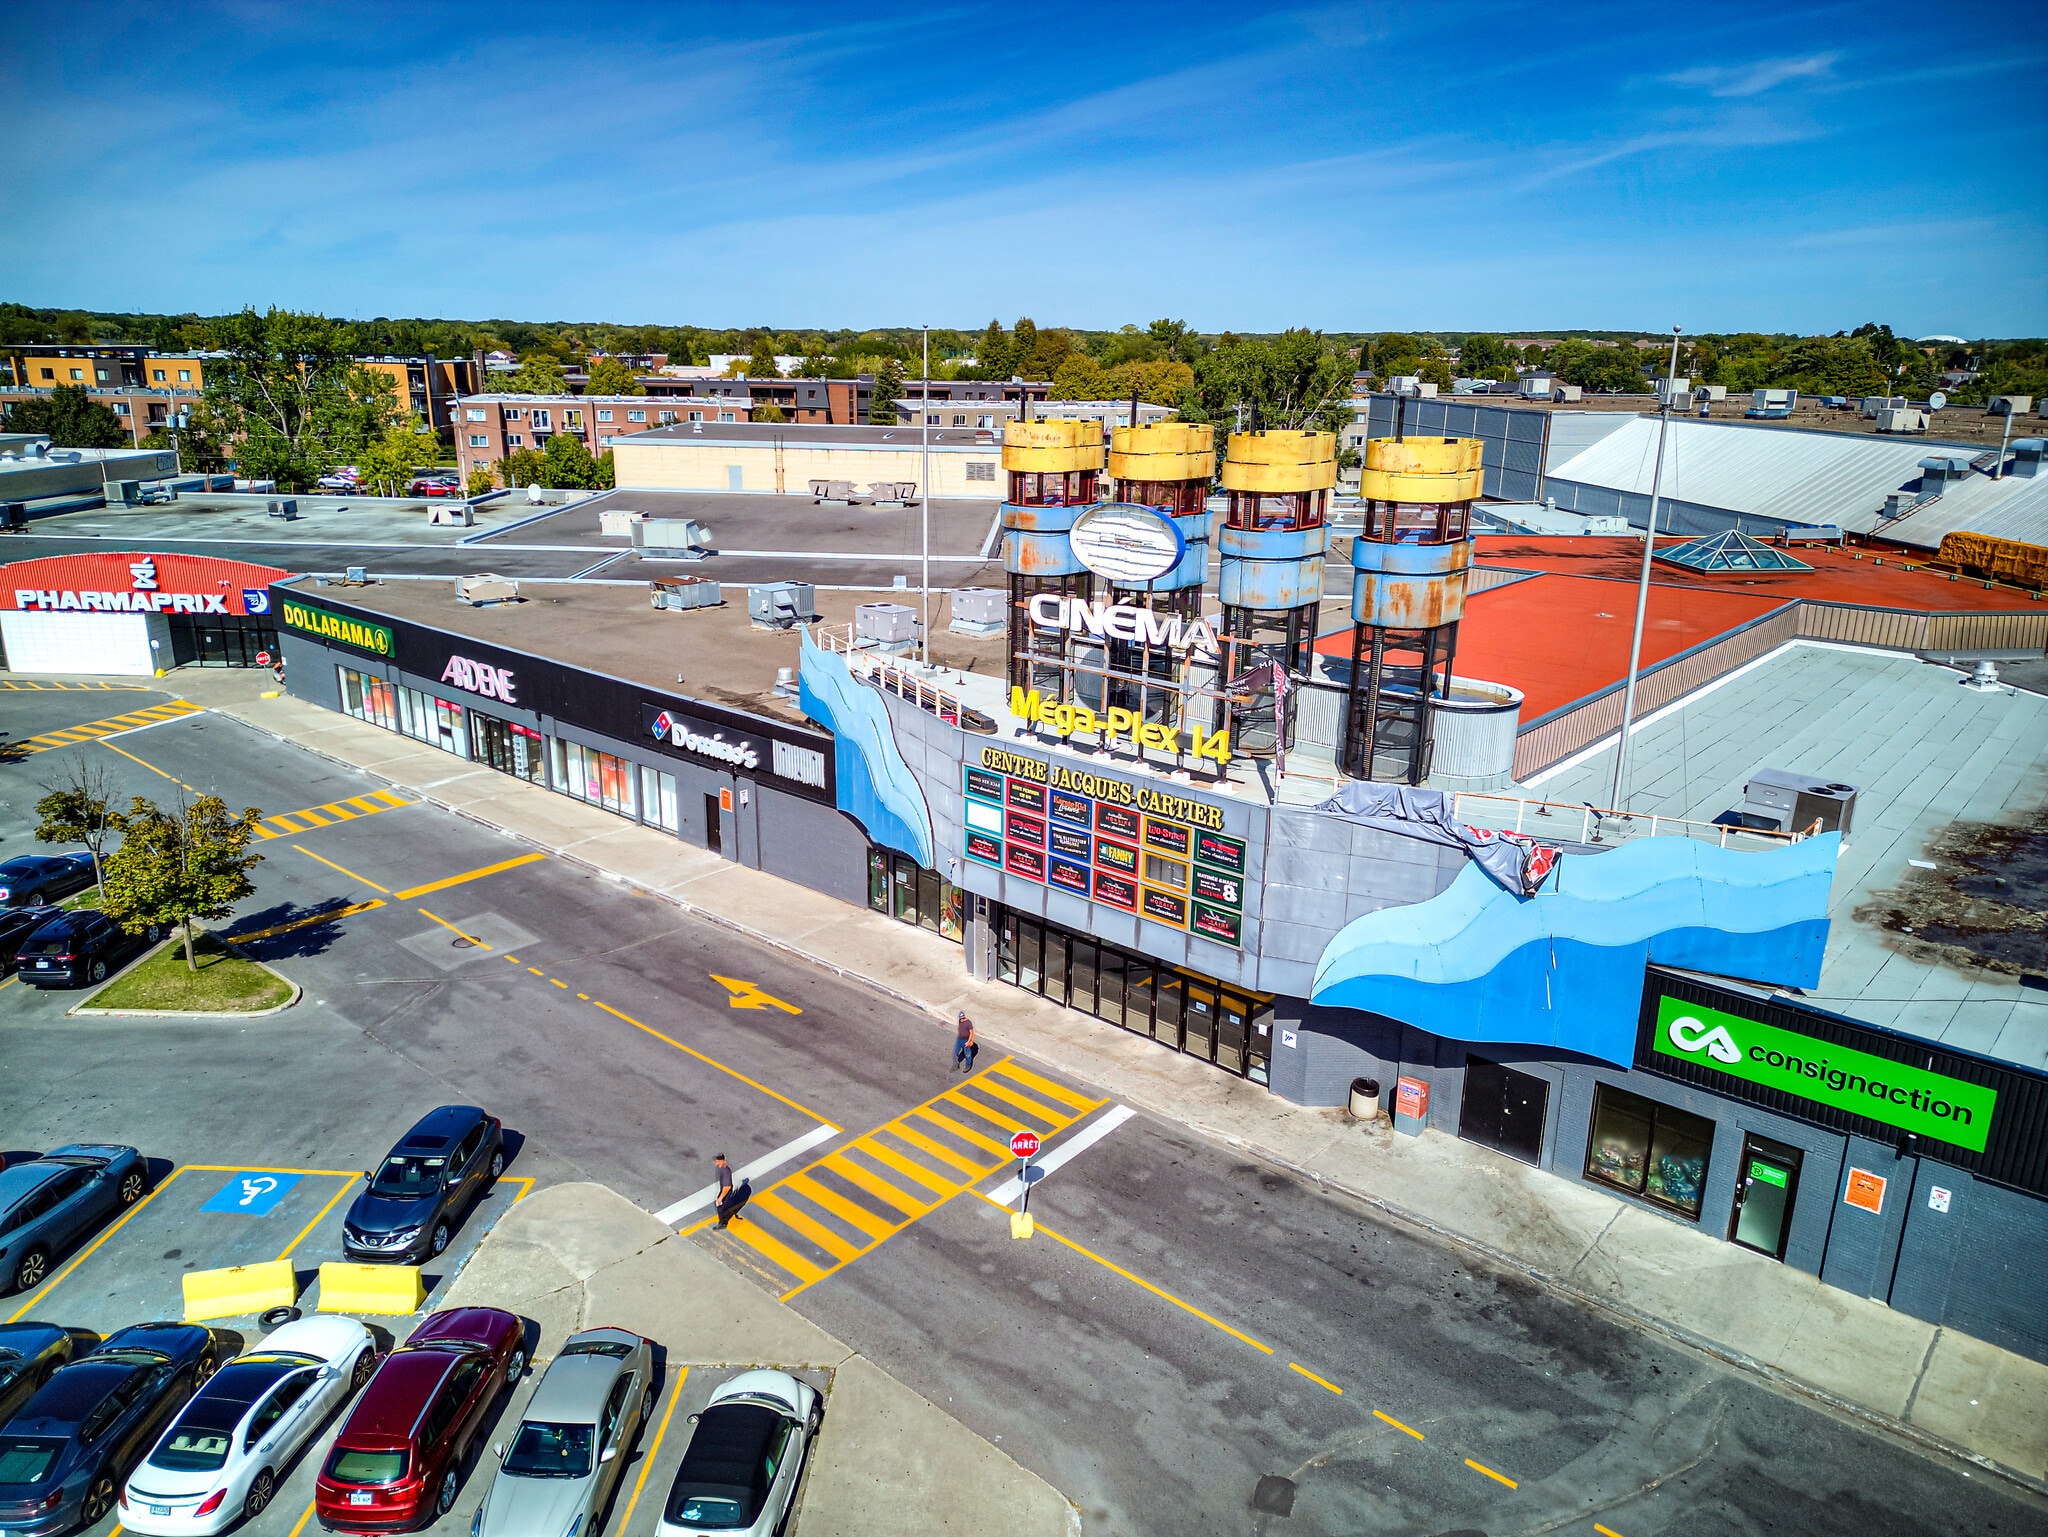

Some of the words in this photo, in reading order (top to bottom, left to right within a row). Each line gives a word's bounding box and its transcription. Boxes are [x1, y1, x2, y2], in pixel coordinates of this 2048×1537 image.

[15, 589, 229, 614] PHARMAPRIX
[1029, 593, 1222, 654] CINÉMA
[283, 604, 375, 650] DOLLARAMA
[440, 655, 517, 703] ARDENE
[672, 723, 757, 769] Domino's
[1011, 686, 1180, 754] Méga-Plex
[1192, 724, 1232, 764] 14
[981, 747, 1049, 782] CENTRE
[1050, 765, 1225, 831] JACQUES-CARTIER
[1108, 846, 1133, 864] FANNY
[1748, 1044, 1973, 1126] consignaction
